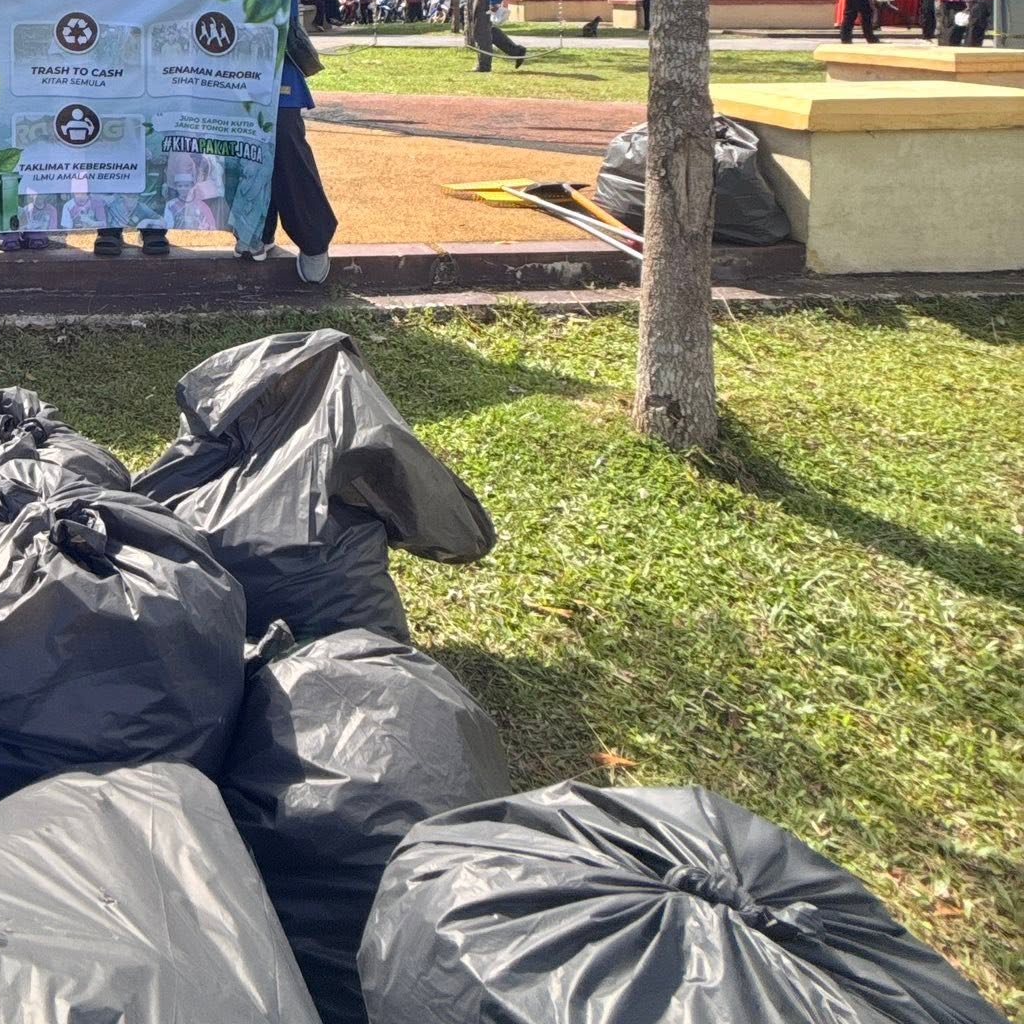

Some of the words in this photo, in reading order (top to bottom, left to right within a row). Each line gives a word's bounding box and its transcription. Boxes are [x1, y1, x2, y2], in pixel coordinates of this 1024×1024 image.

[31, 66, 69, 75] TRASH
[73, 67, 88, 76] TO
[91, 69, 123, 77] CASH
[162, 66, 213, 77] SENAMAN
[215, 70, 262, 80] AEROBIK
[41, 77, 68, 85] KITAR
[70, 78, 106, 87] SEMULA
[172, 77, 199, 85] SIHAT
[201, 79, 247, 89] BERSAMA
[162, 136, 263, 164] #KITAPAKATJAGA
[19, 163, 70, 171] TAKLIMAT
[72, 162, 138, 171] KEBERSIHAN
[56, 173, 95, 181] AMALAN
